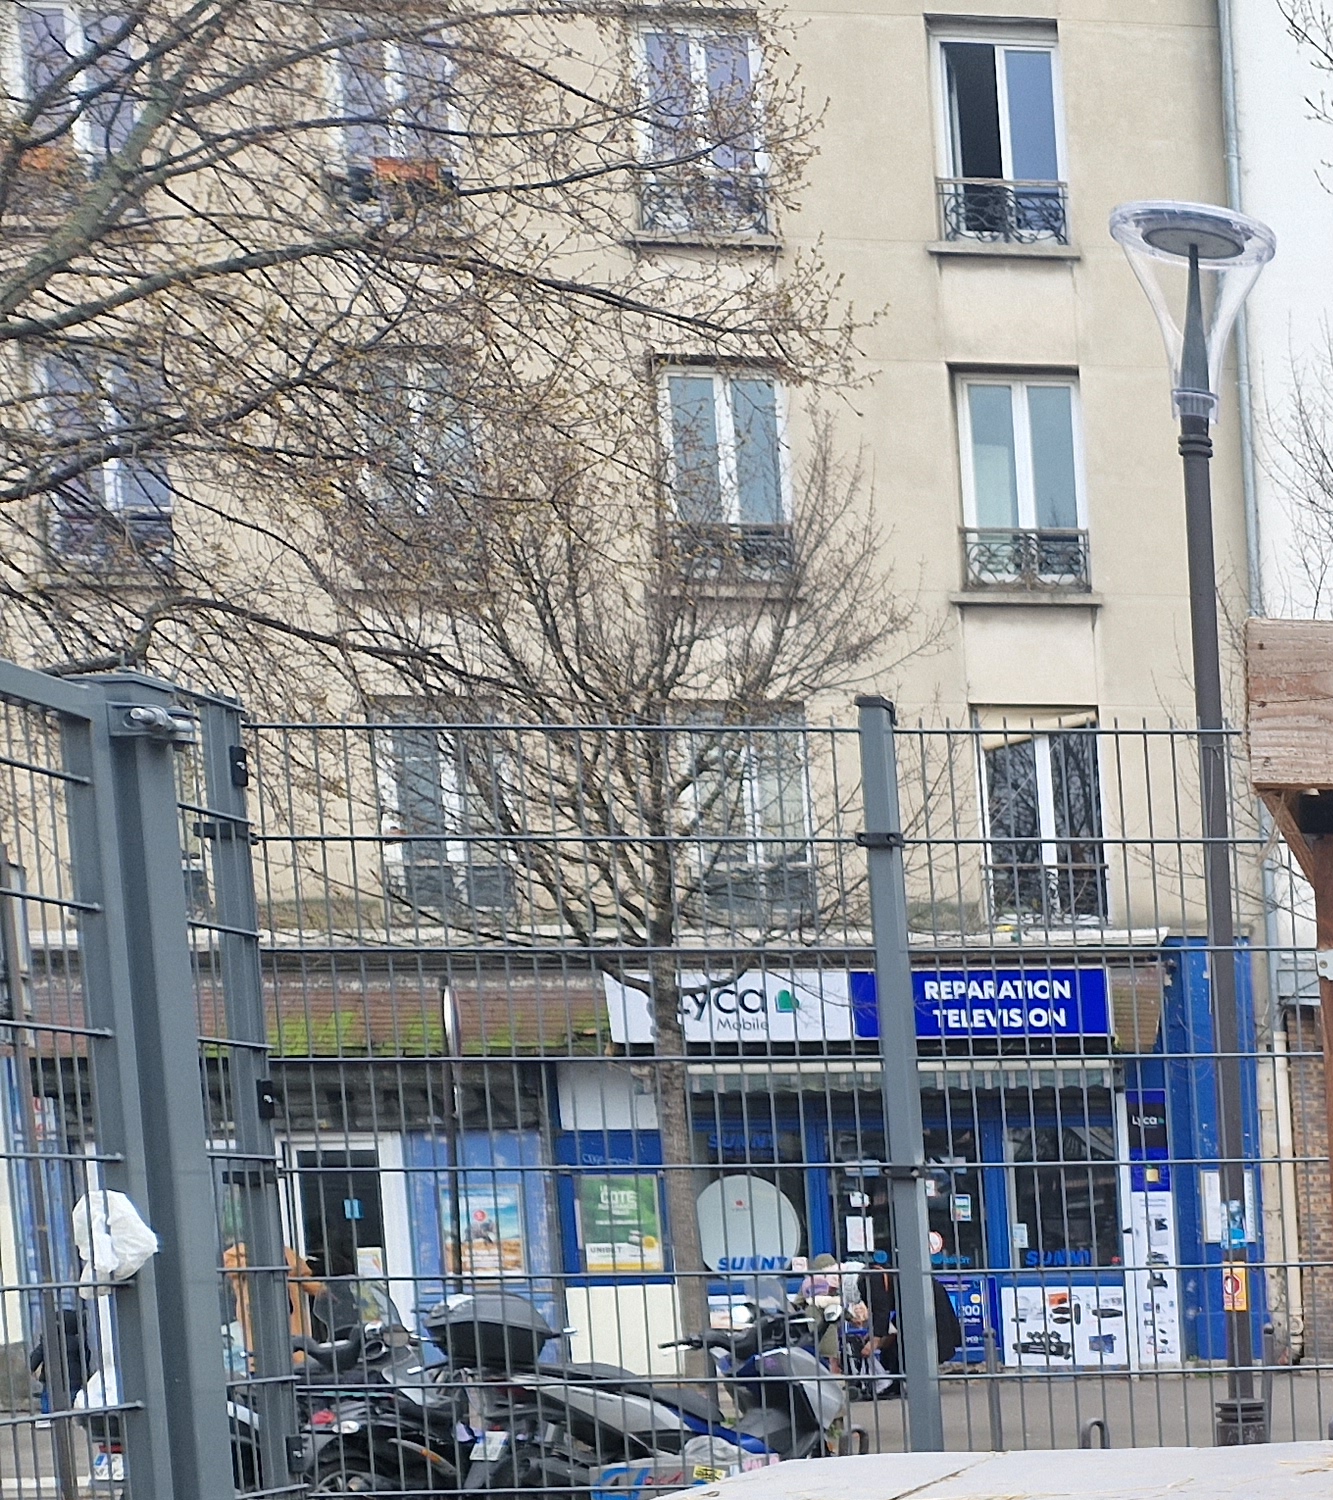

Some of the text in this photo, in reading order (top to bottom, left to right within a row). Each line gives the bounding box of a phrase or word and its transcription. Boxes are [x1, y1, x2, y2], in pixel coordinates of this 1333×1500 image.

[924, 979, 1072, 1001] REPARATION
[677, 988, 768, 1021] yca
[716, 1017, 769, 1032] Mobile
[932, 1007, 1068, 1029] TELEVISON
[590, 1246, 623, 1254] UNIBT
